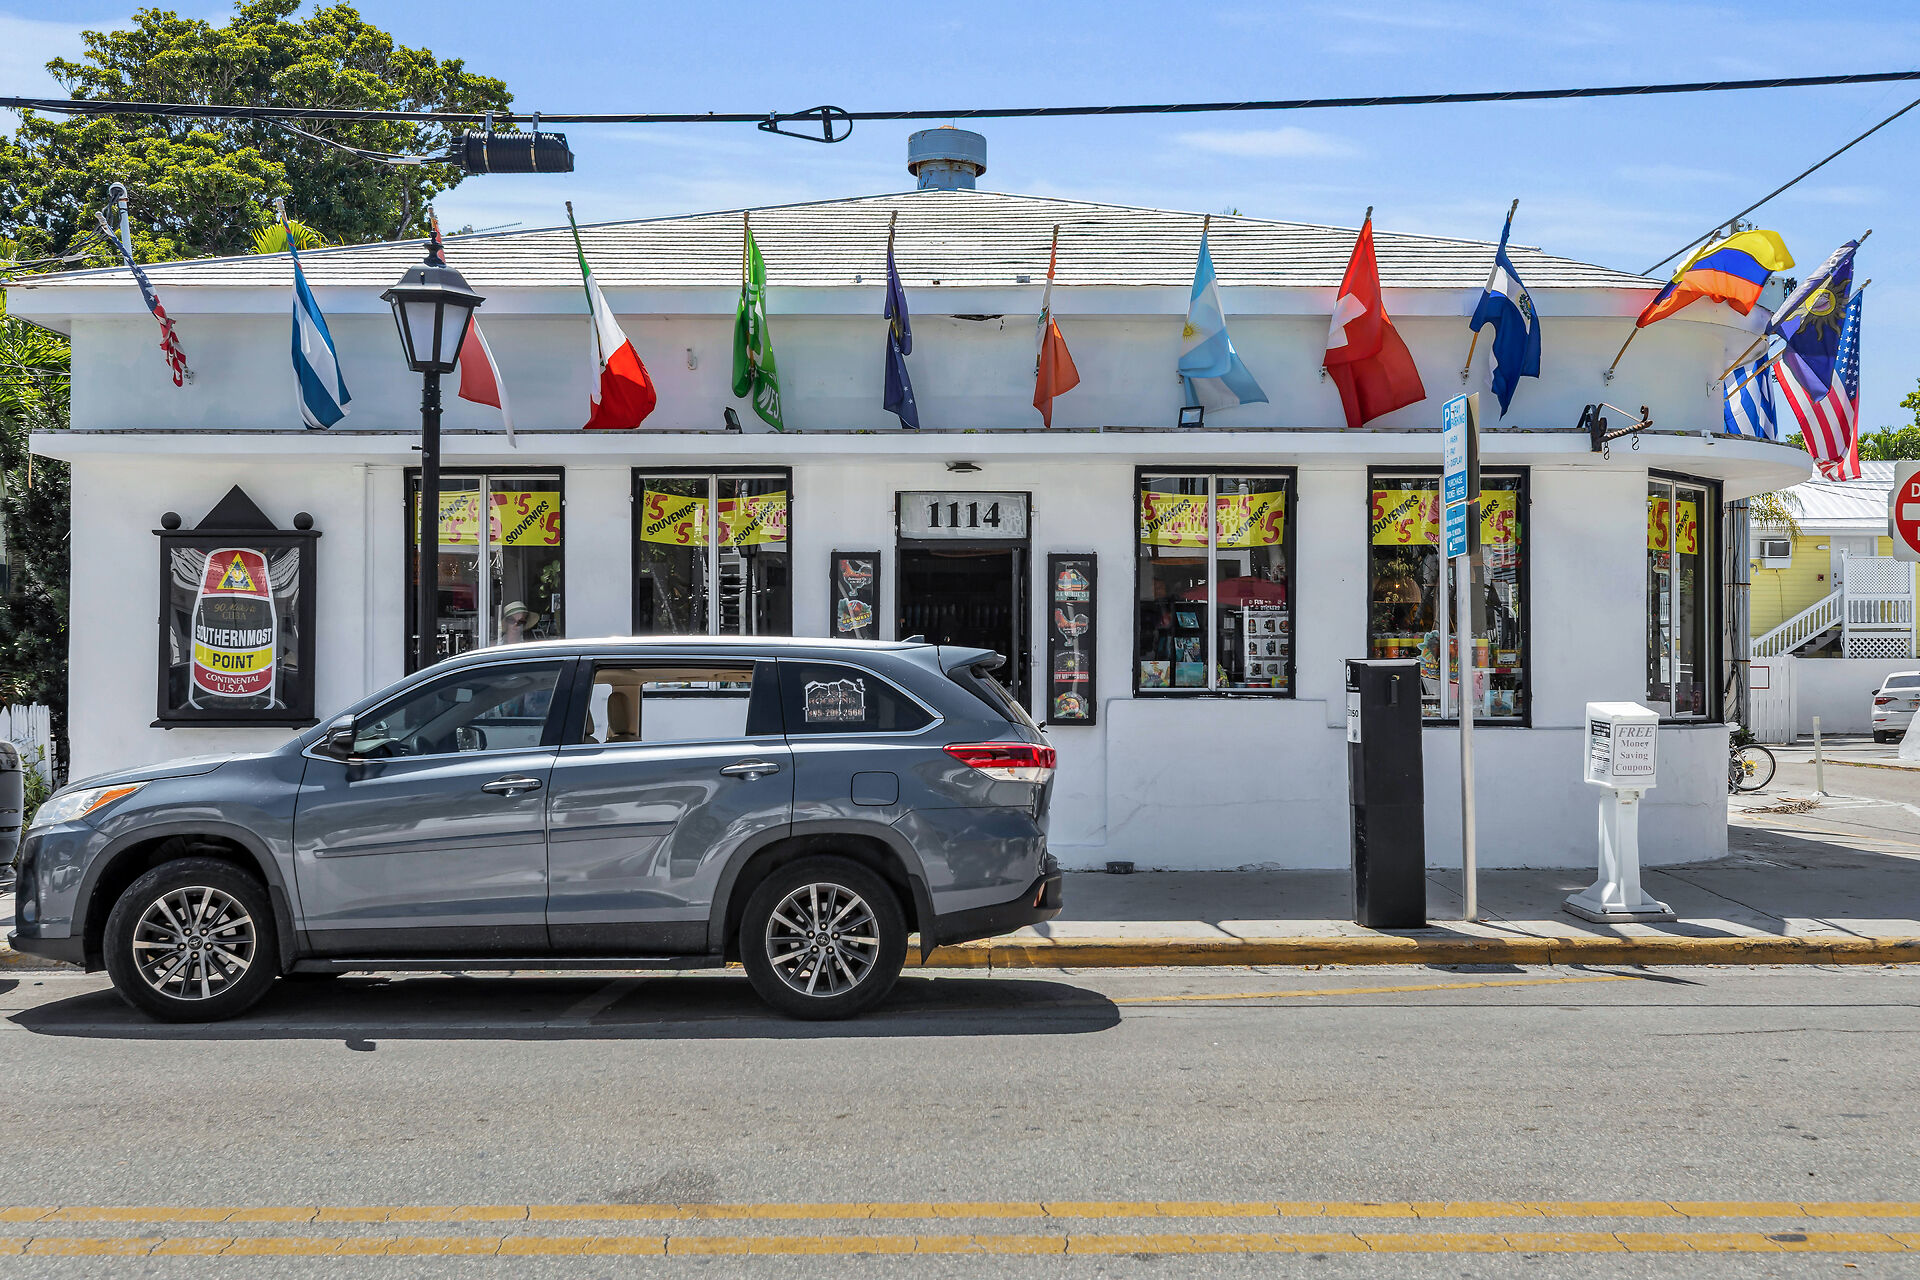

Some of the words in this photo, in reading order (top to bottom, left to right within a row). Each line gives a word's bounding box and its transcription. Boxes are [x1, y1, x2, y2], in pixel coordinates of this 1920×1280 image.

[1444, 407, 1450, 430] P
[1912, 483, 1920, 498] D
[505, 500, 549, 544] SOUVENIRS
[646, 502, 698, 536] SOUVENIRS
[734, 501, 775, 546] SOUVENIRS
[927, 502, 1000, 527] 1114
[1141, 499, 1192, 537] SOUVENIRS
[1226, 502, 1270, 546] SOUVENIRS
[1259, 510, 1283, 543] $5
[1394, 518, 1414, 543] $5
[222, 612, 246, 620] CUBA
[196, 625, 272, 647] SOUTHERNMOST
[212, 653, 254, 669] POINT
[205, 672, 260, 684] CONTINENTAL
[217, 683, 248, 692] U.S.A.
[1618, 727, 1654, 737] FREE
[1622, 740, 1649, 749] Money
[1620, 752, 1648, 760] Saving
[1616, 764, 1652, 772] Coupons
